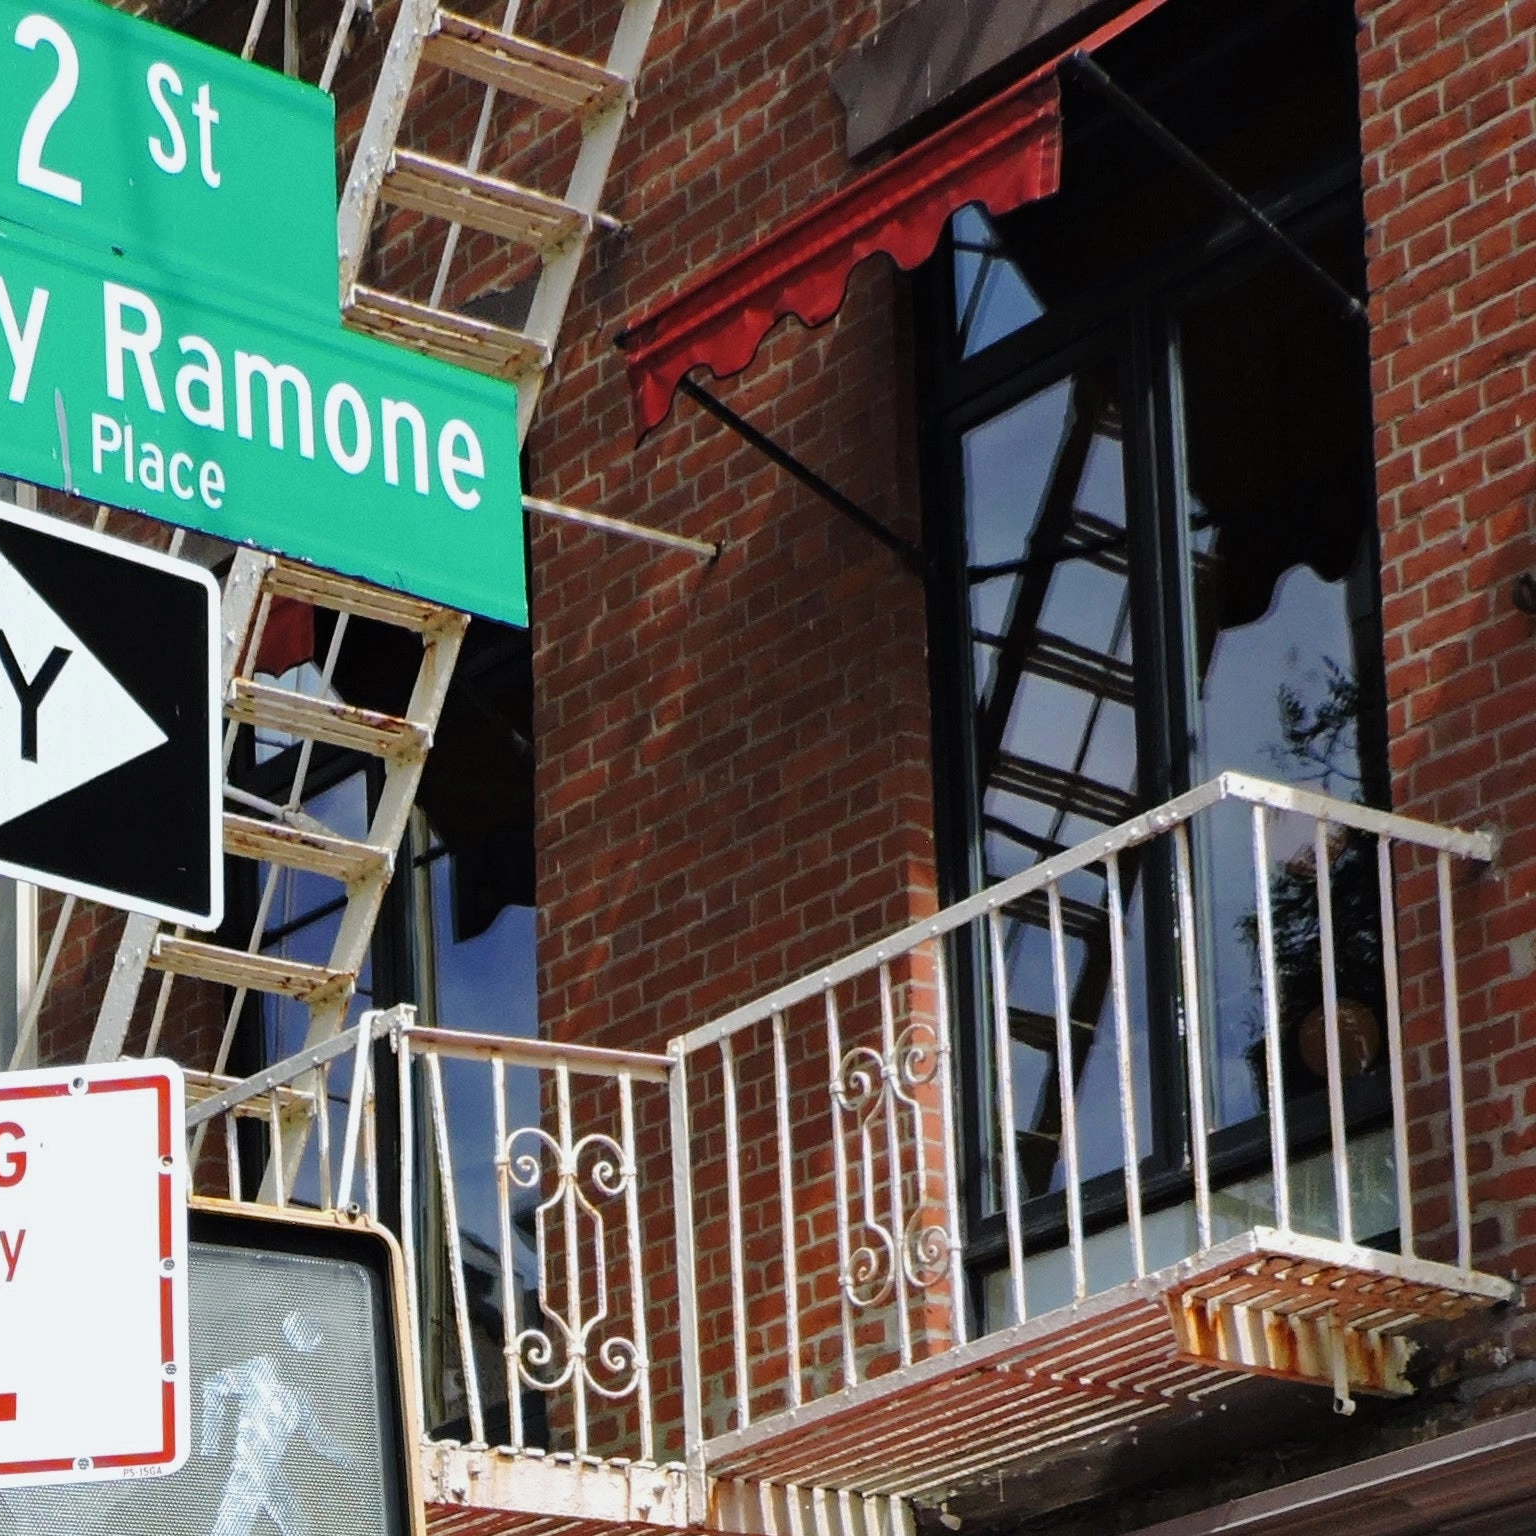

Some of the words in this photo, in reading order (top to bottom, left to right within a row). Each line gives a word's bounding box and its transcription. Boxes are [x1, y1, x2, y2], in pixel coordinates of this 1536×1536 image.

[14, 14, 82, 206] 2
[146, 62, 221, 188] St
[91, 412, 226, 508] Place
[102, 281, 485, 510] Ramone
